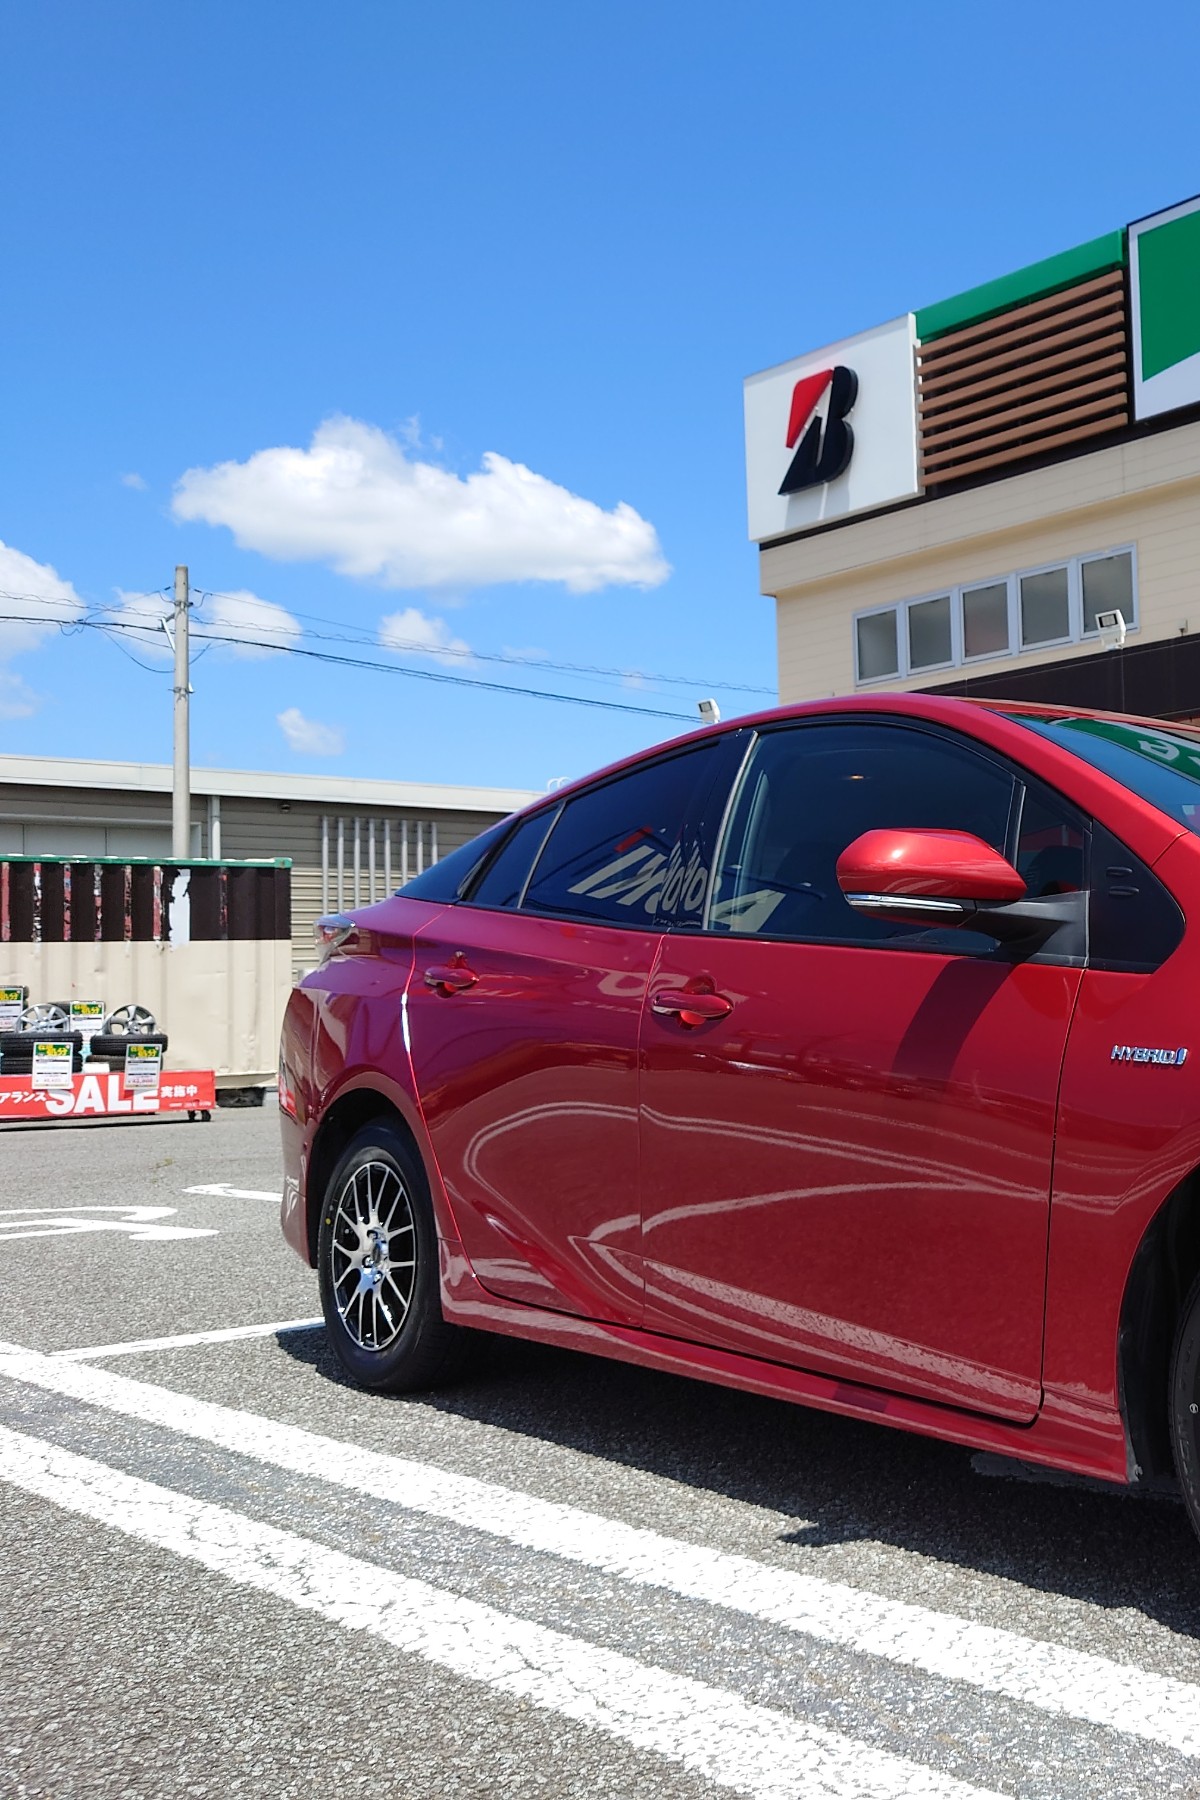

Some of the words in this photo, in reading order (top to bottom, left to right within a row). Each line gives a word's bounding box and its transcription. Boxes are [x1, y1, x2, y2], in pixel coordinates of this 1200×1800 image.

[1110, 1045, 1176, 1064] HYBRID
[161, 1085, 198, 1099] 実施中
